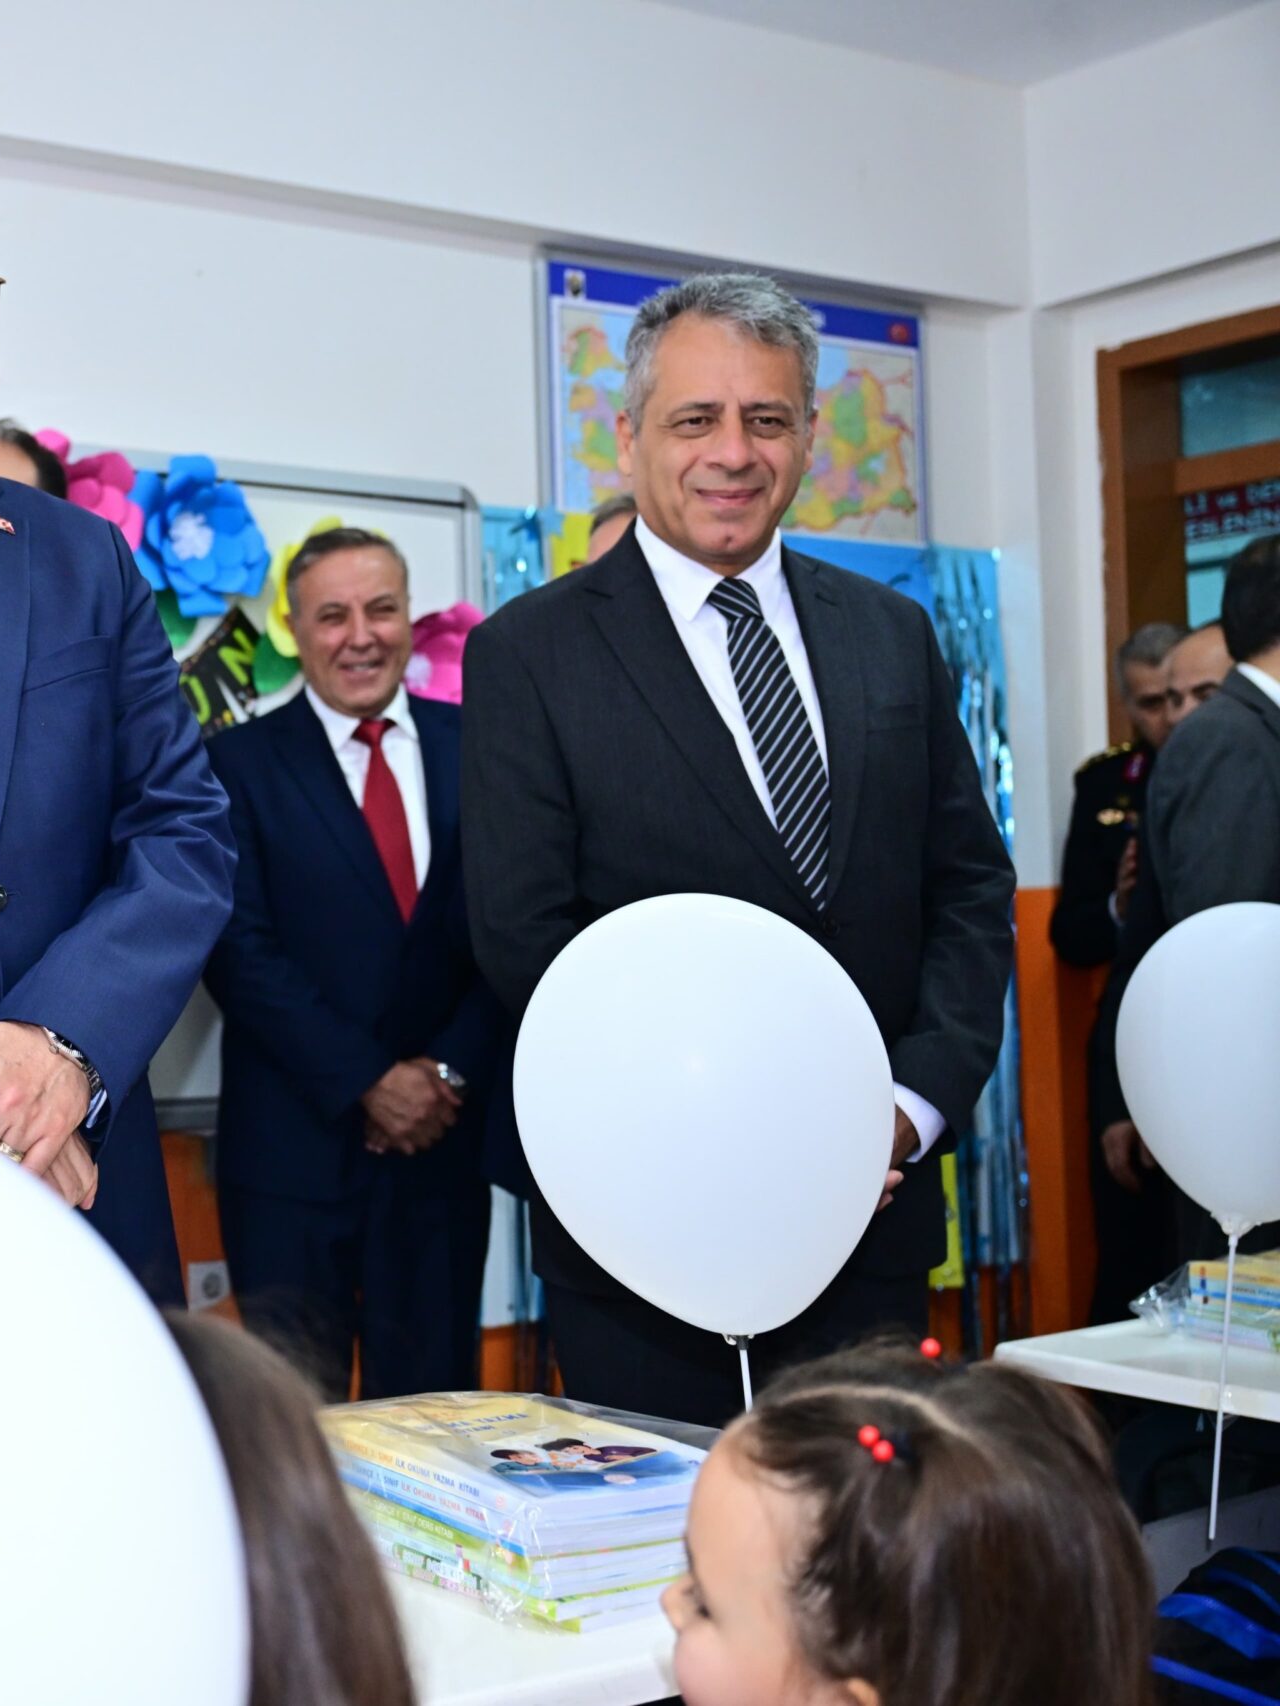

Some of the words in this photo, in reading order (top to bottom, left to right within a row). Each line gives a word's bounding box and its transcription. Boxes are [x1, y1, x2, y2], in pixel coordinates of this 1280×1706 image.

[407, 1463, 431, 1478] OKUMA
[433, 1471, 455, 1488] YAZMA
[458, 1478, 480, 1497] KİTABI
[413, 1488, 436, 1502] OKUMA
